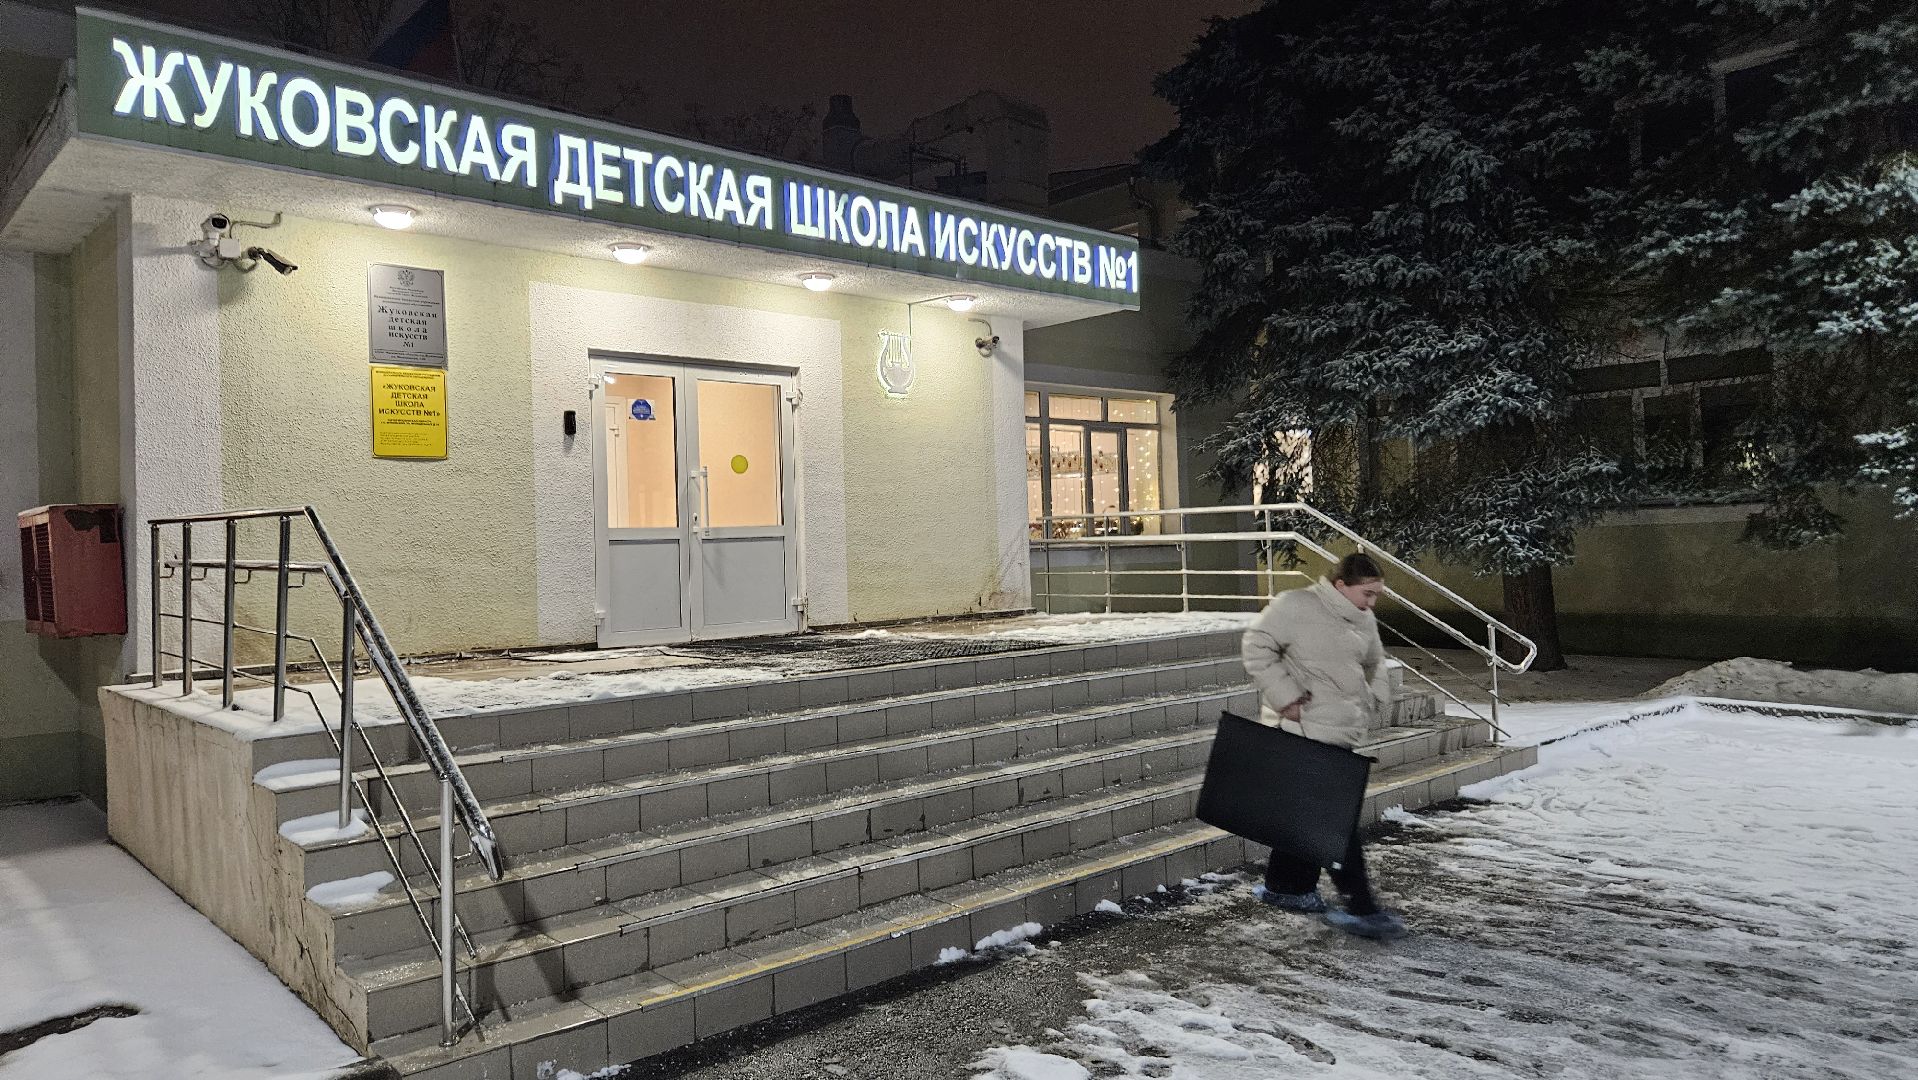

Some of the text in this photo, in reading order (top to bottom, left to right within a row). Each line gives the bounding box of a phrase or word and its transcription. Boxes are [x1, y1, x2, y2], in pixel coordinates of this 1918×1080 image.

[112, 38, 1138, 293] ЖУКОВСКАЯ ДЕТСКАЯ ШКОЛА ИСКУССТВ №1
[378, 305, 437, 318] Жуковская
[391, 392, 428, 400] ДЕТСКАЯ
[378, 408, 422, 416] ИСКУССТВ
